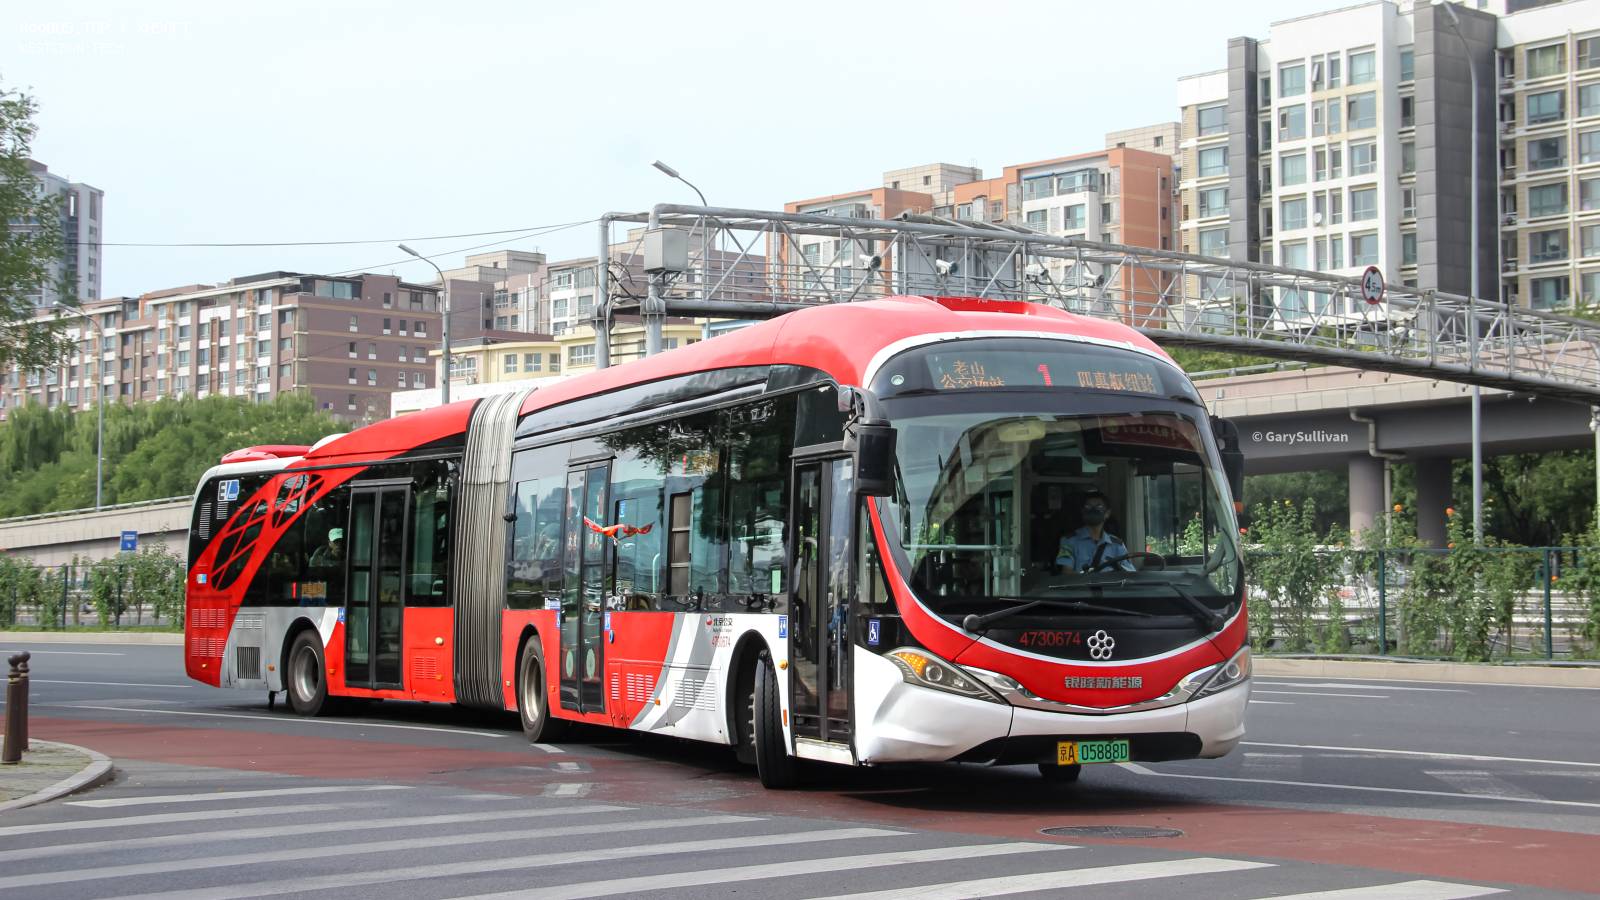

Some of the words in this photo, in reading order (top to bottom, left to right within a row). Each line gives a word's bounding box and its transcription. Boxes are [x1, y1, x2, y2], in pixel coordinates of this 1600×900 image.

[1038, 364, 1053, 386] 1
[1019, 631, 1081, 647] 4730674
[1064, 676, 1142, 688] 银隆新能源
